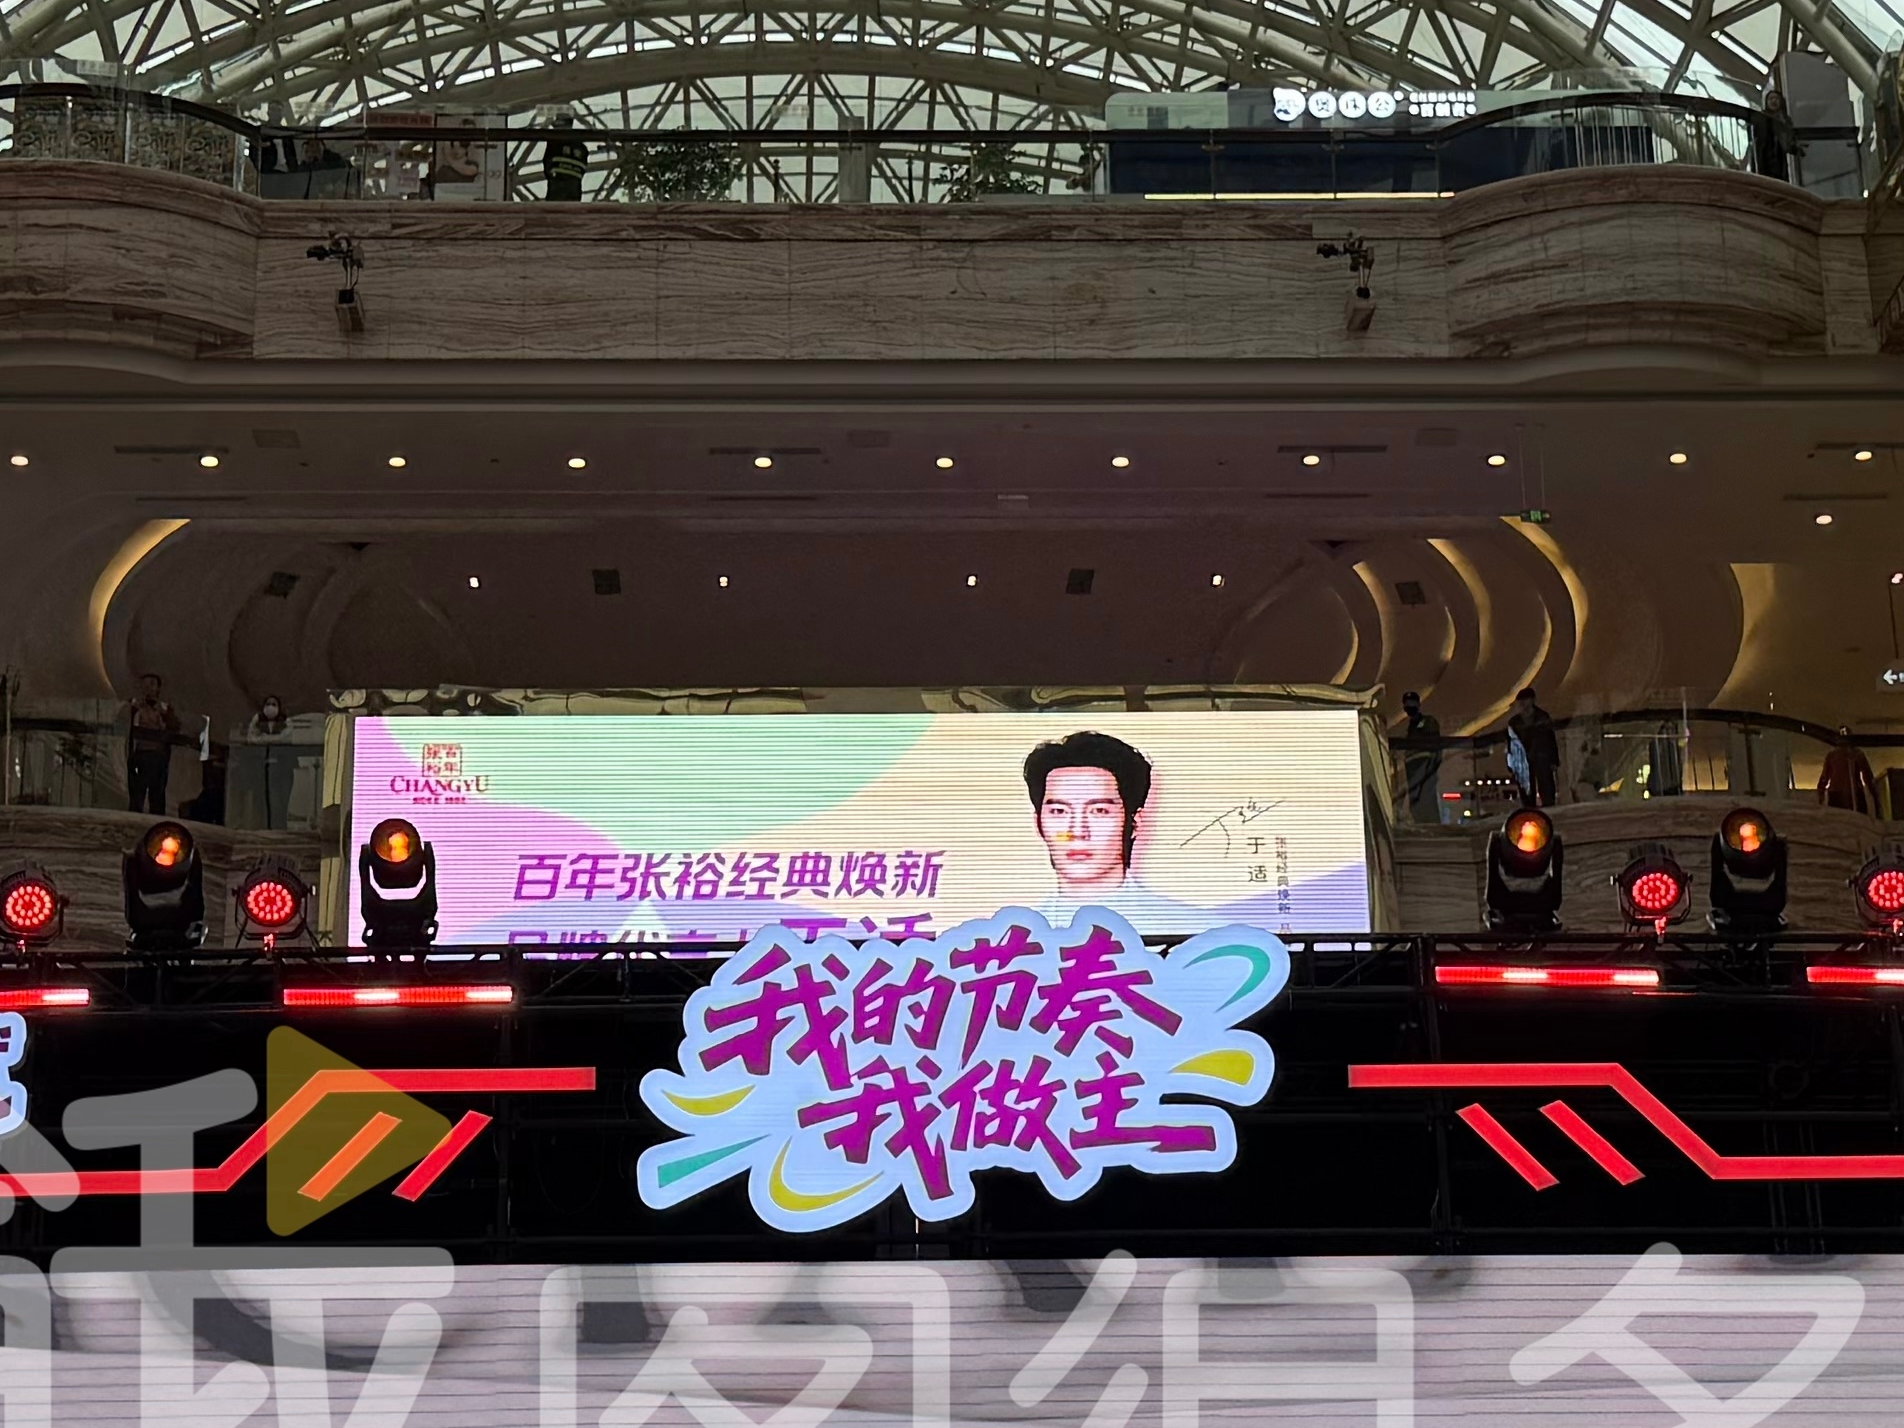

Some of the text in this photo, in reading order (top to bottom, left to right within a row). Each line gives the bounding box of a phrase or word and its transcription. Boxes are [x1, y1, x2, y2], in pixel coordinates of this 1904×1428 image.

[390, 775, 490, 796] CHANGYU
[512, 850, 946, 901] 百年张裕经典焕新
[698, 924, 1182, 1091] 我的节奏
[797, 1051, 1216, 1201] 我做主
